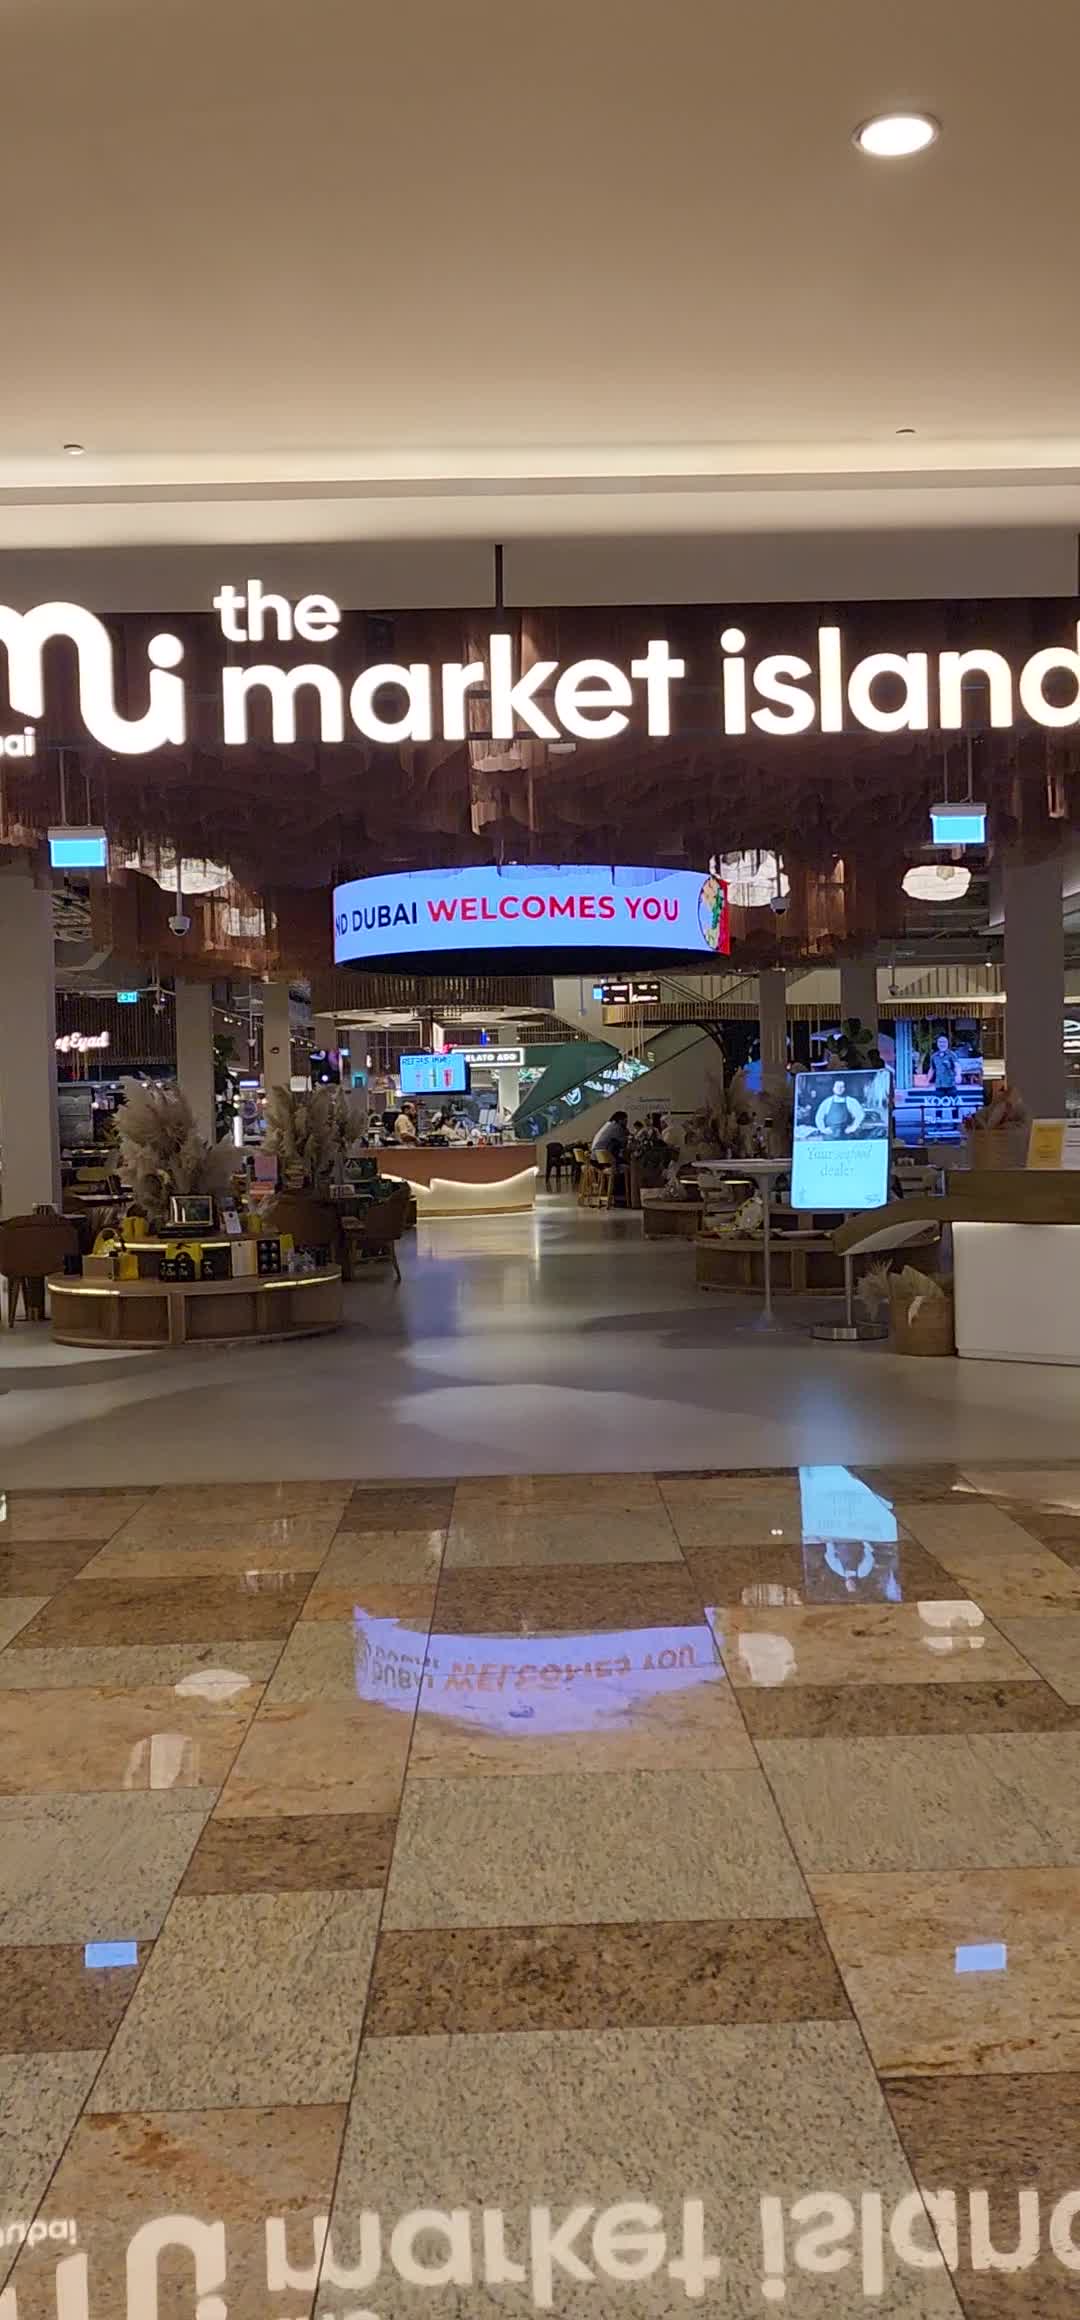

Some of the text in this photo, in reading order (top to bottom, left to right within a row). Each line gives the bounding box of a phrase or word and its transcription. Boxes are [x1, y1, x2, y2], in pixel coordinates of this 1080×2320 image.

[214, 581, 341, 643] the
[221, 633, 686, 745] market
[0, 727, 36, 758] ai
[352, 902, 418, 932] DUBAI
[427, 896, 615, 922] WELCOMES
[625, 896, 679, 922] YOU
[465, 1054, 496, 1062] ELATO
